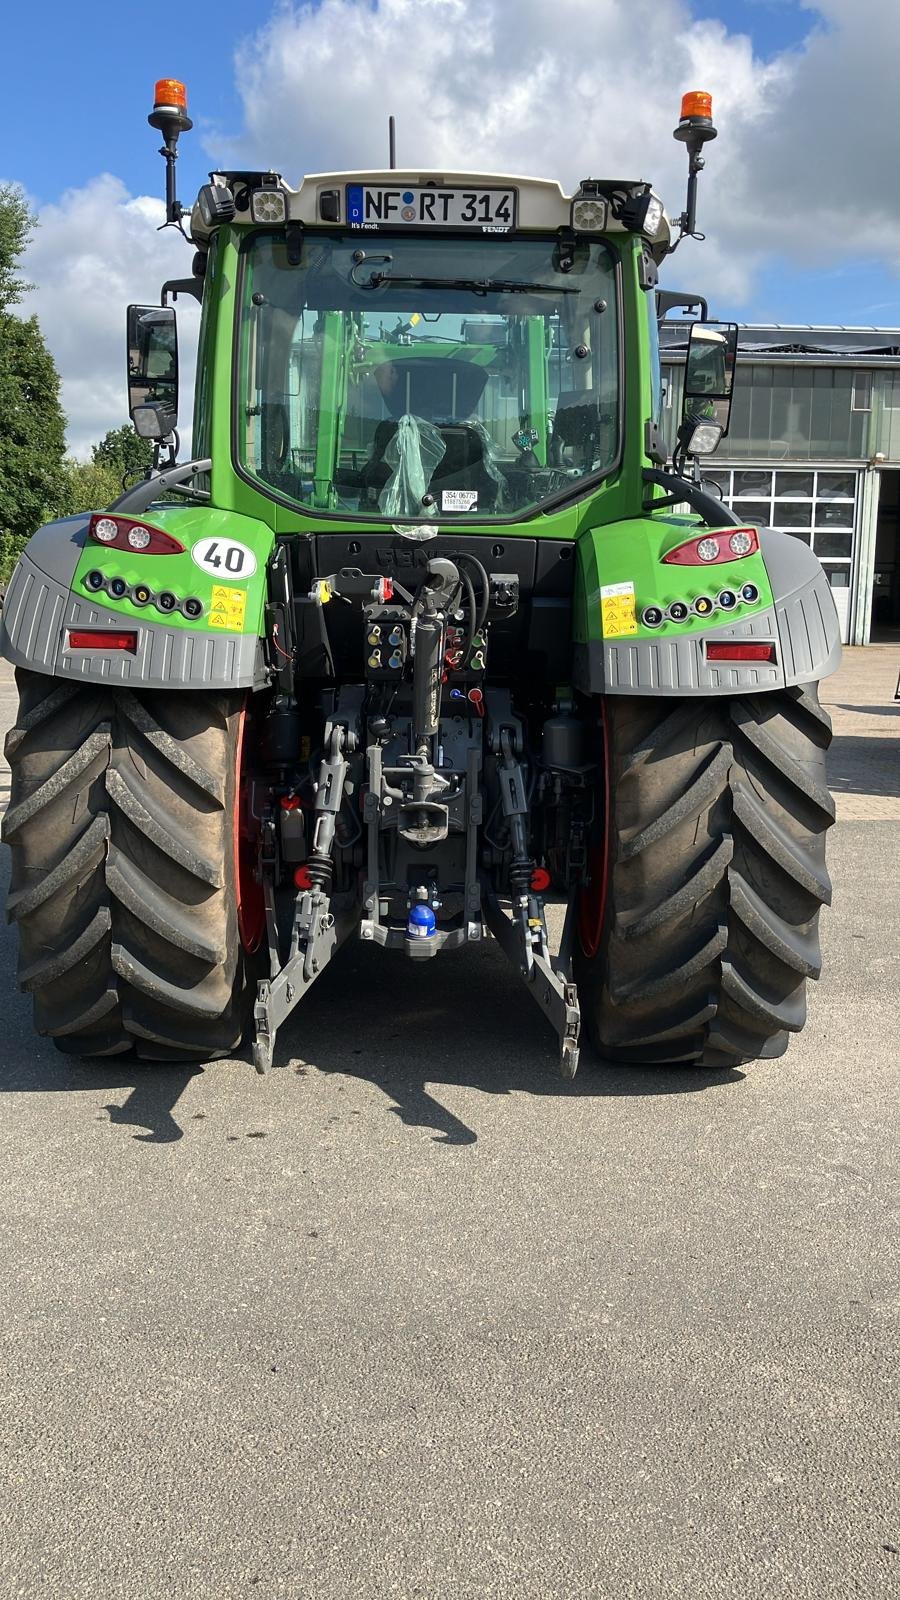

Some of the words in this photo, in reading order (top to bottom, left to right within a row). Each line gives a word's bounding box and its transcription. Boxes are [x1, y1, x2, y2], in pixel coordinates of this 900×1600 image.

[353, 208, 359, 217] D
[365, 191, 400, 219] NF
[419, 193, 454, 221] RT
[461, 194, 511, 223] 314
[203, 542, 245, 572] 40
